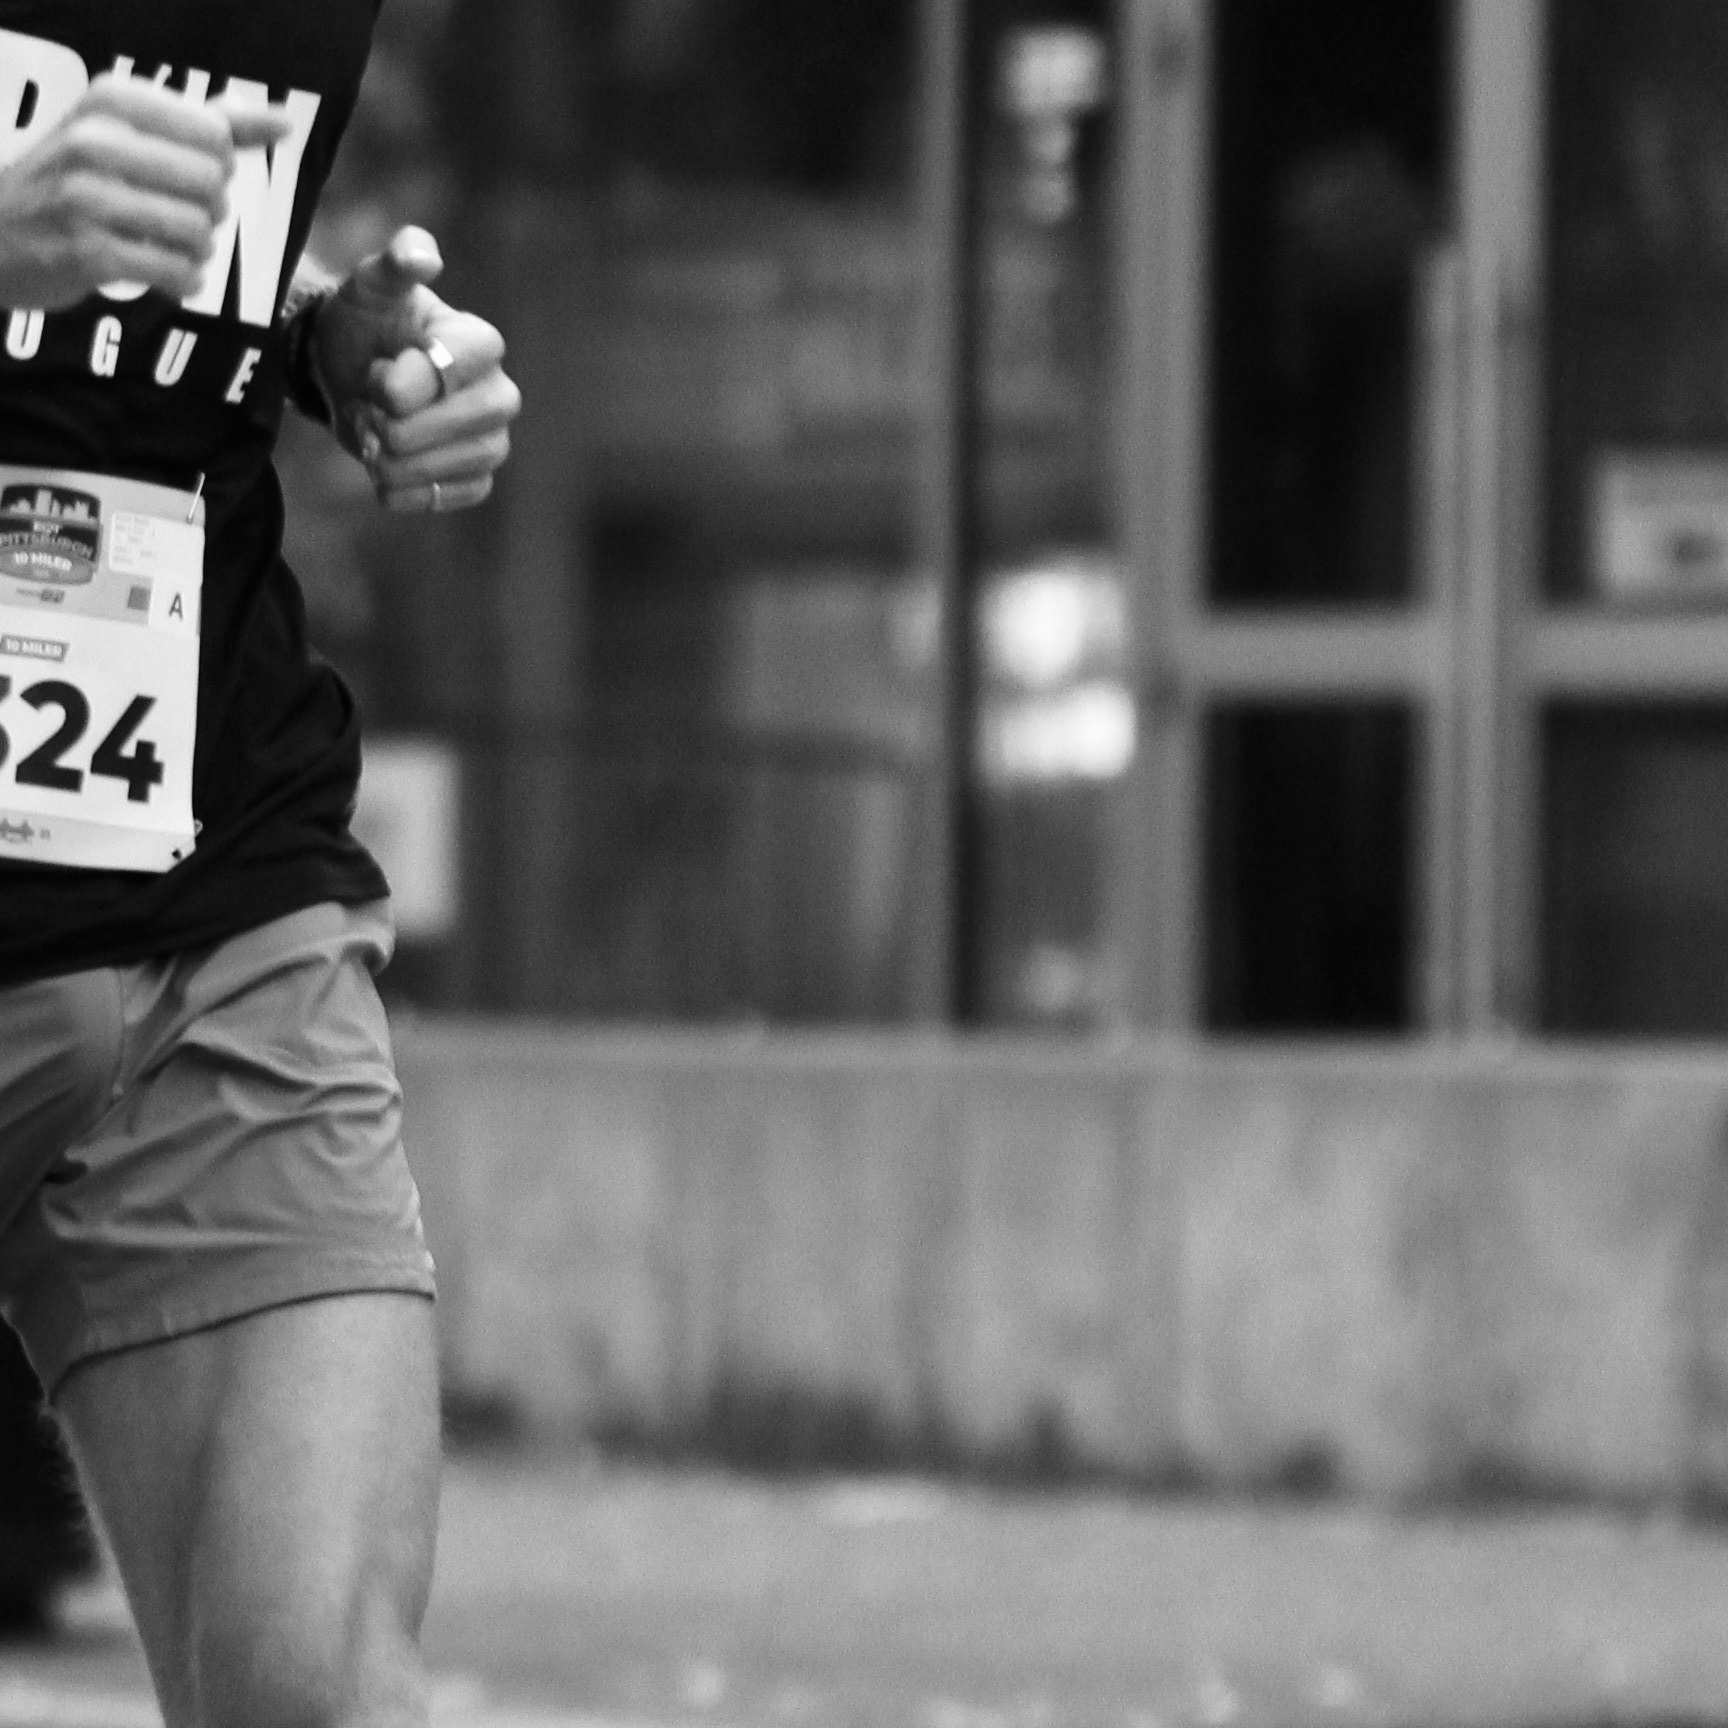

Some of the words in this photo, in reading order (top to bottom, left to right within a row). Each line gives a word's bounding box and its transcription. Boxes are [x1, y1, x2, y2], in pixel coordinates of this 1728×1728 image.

[14, 551, 29, 565] 10
[31, 552, 72, 571] MILER
[168, 592, 183, 620] A
[6, 638, 20, 653] 10
[22, 639, 63, 658] MILER
